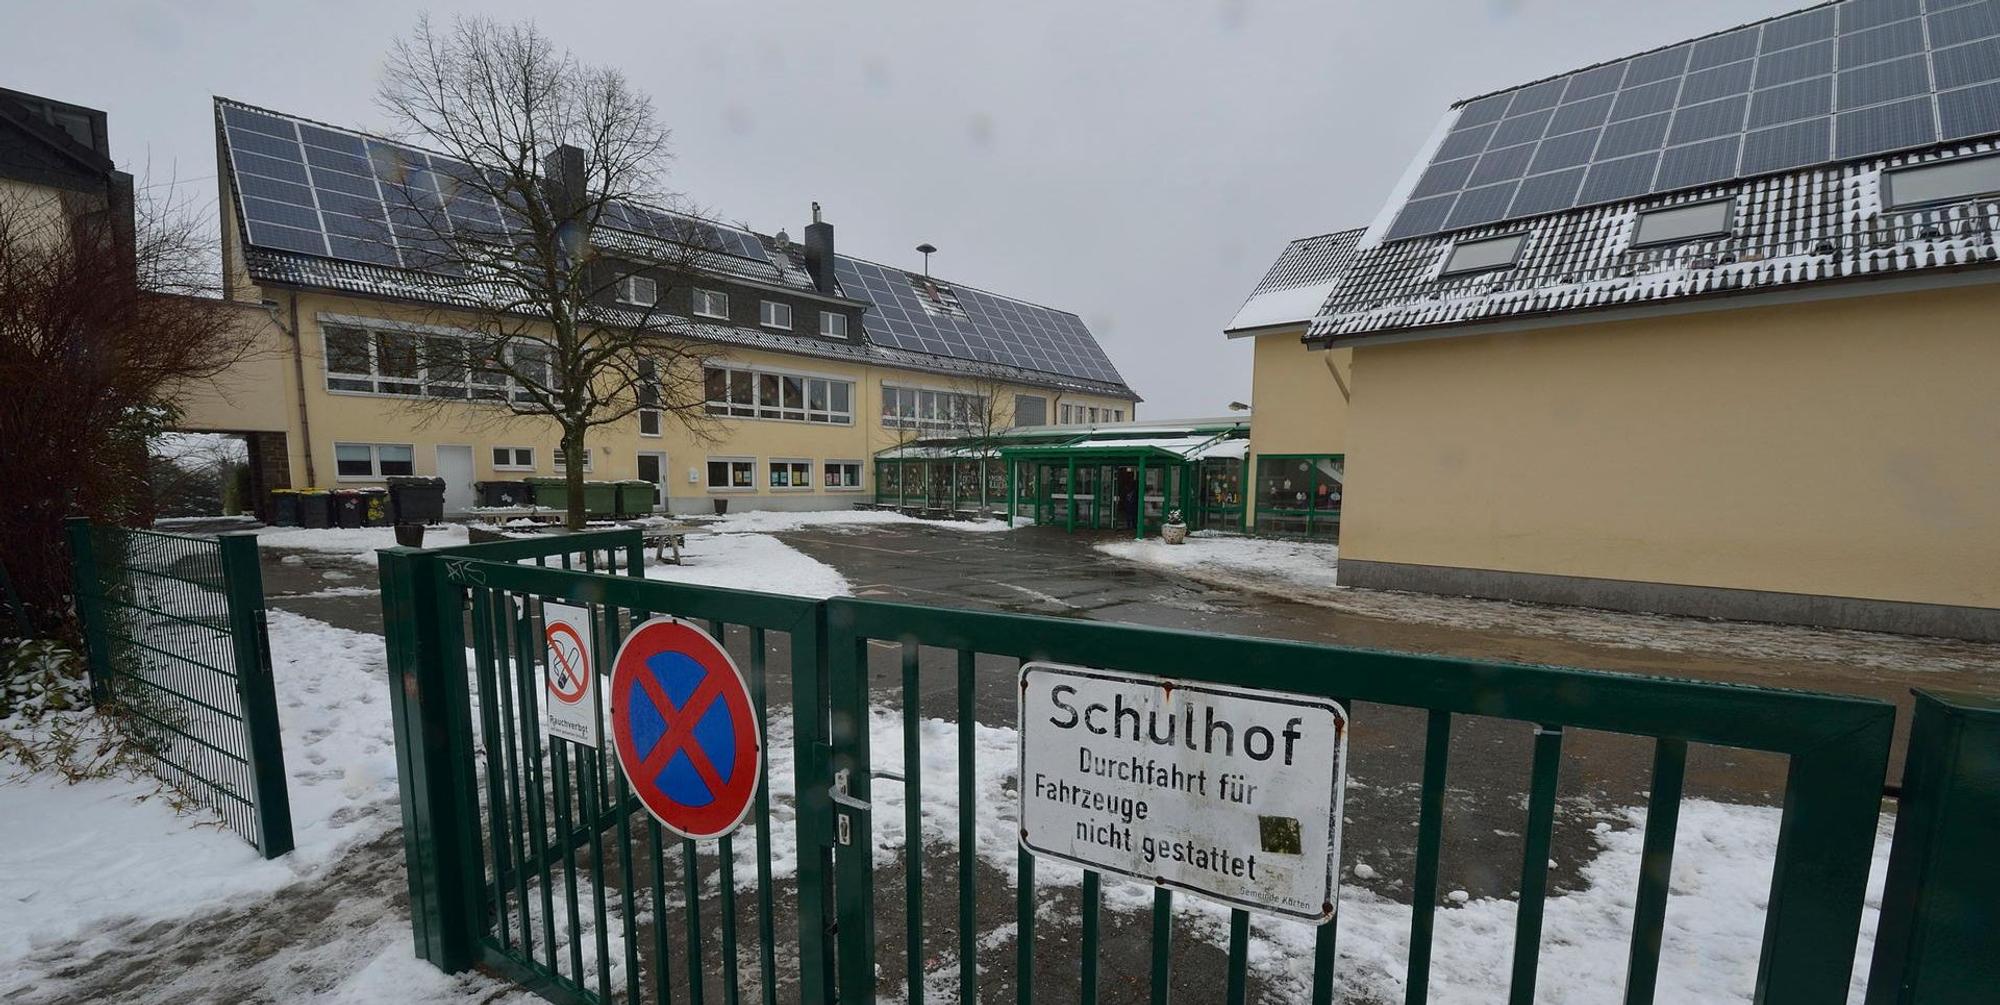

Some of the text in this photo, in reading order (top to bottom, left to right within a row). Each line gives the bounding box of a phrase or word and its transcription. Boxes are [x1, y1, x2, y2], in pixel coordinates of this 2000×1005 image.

[1049, 684, 1302, 766] Schulhof
[1035, 773, 1149, 823] Fahrzeuge
[1079, 746, 1258, 805] Durchfahrt für
[1076, 819, 1256, 881] nicht gestattet
